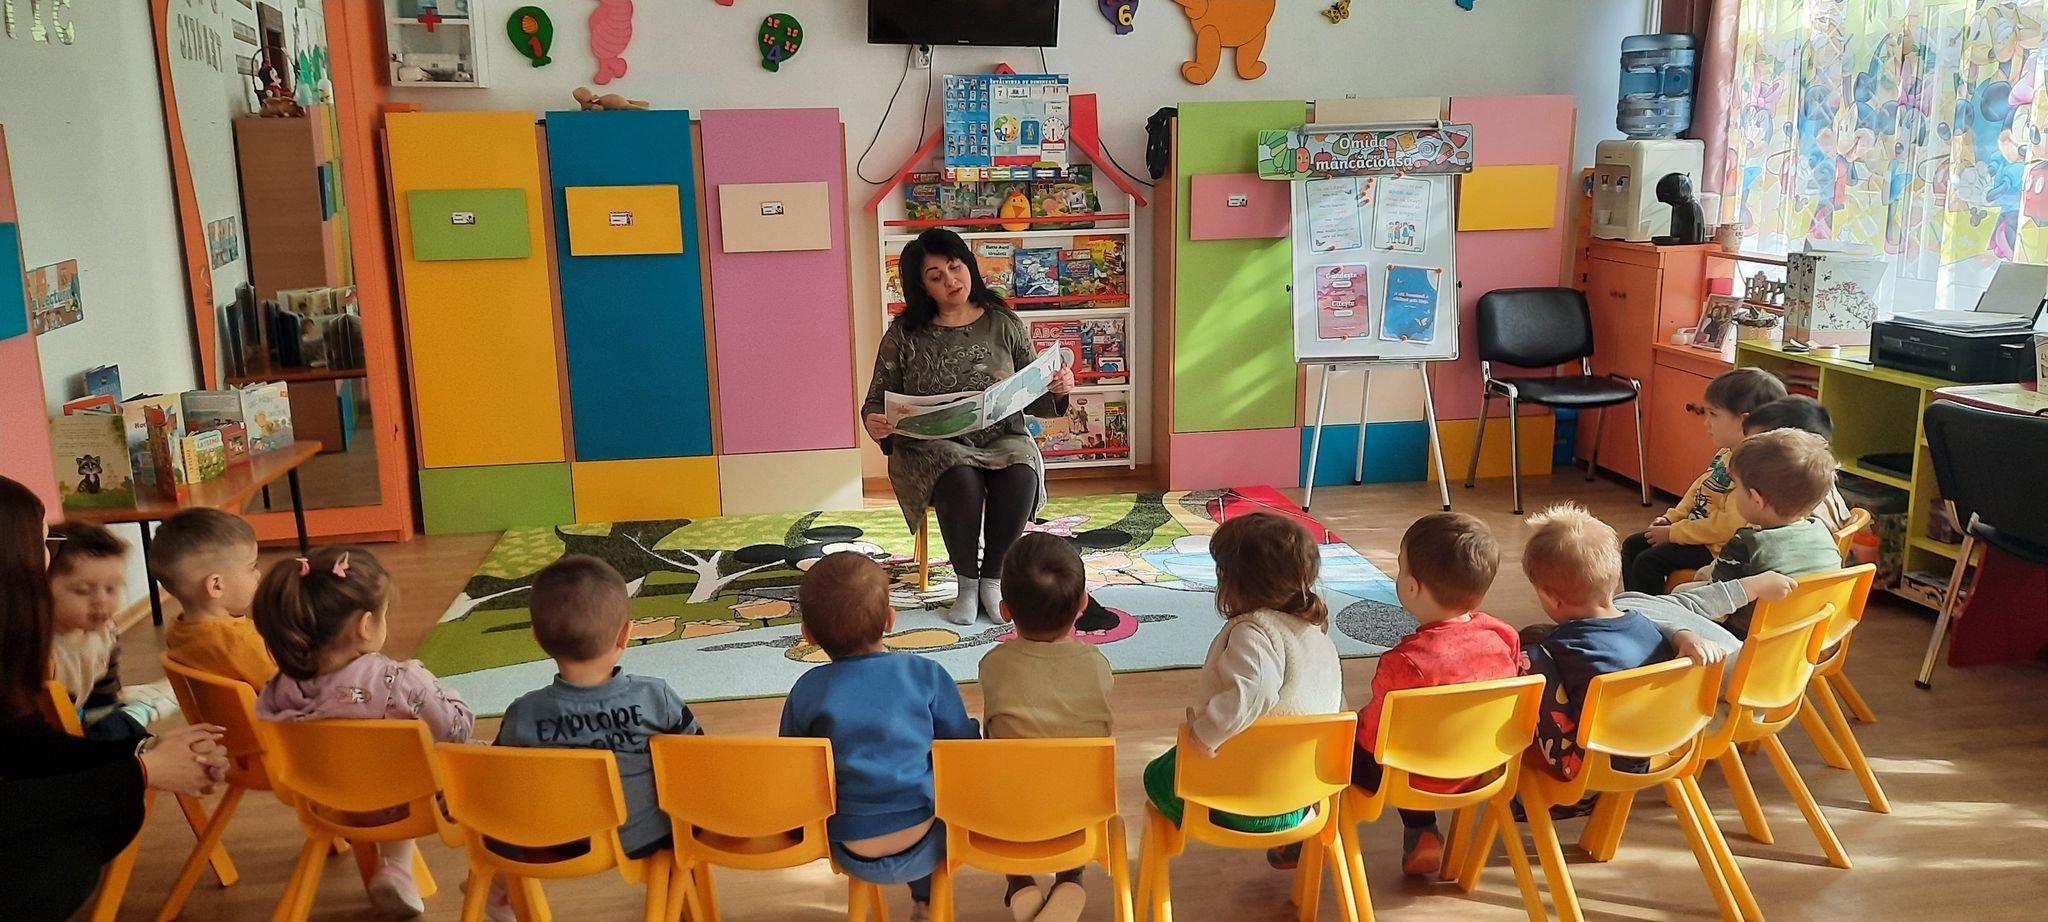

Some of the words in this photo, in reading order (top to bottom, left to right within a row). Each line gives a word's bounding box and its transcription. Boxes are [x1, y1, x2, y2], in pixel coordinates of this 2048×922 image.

[1119, 4, 1132, 26] 6
[528, 36, 543, 57] 1
[767, 44, 783, 64] 4
[1340, 135, 1388, 149] Omida
[1316, 153, 1413, 170] mâncăcioasă
[1032, 327, 1060, 339] ABC
[536, 704, 643, 743] EXPLORE
